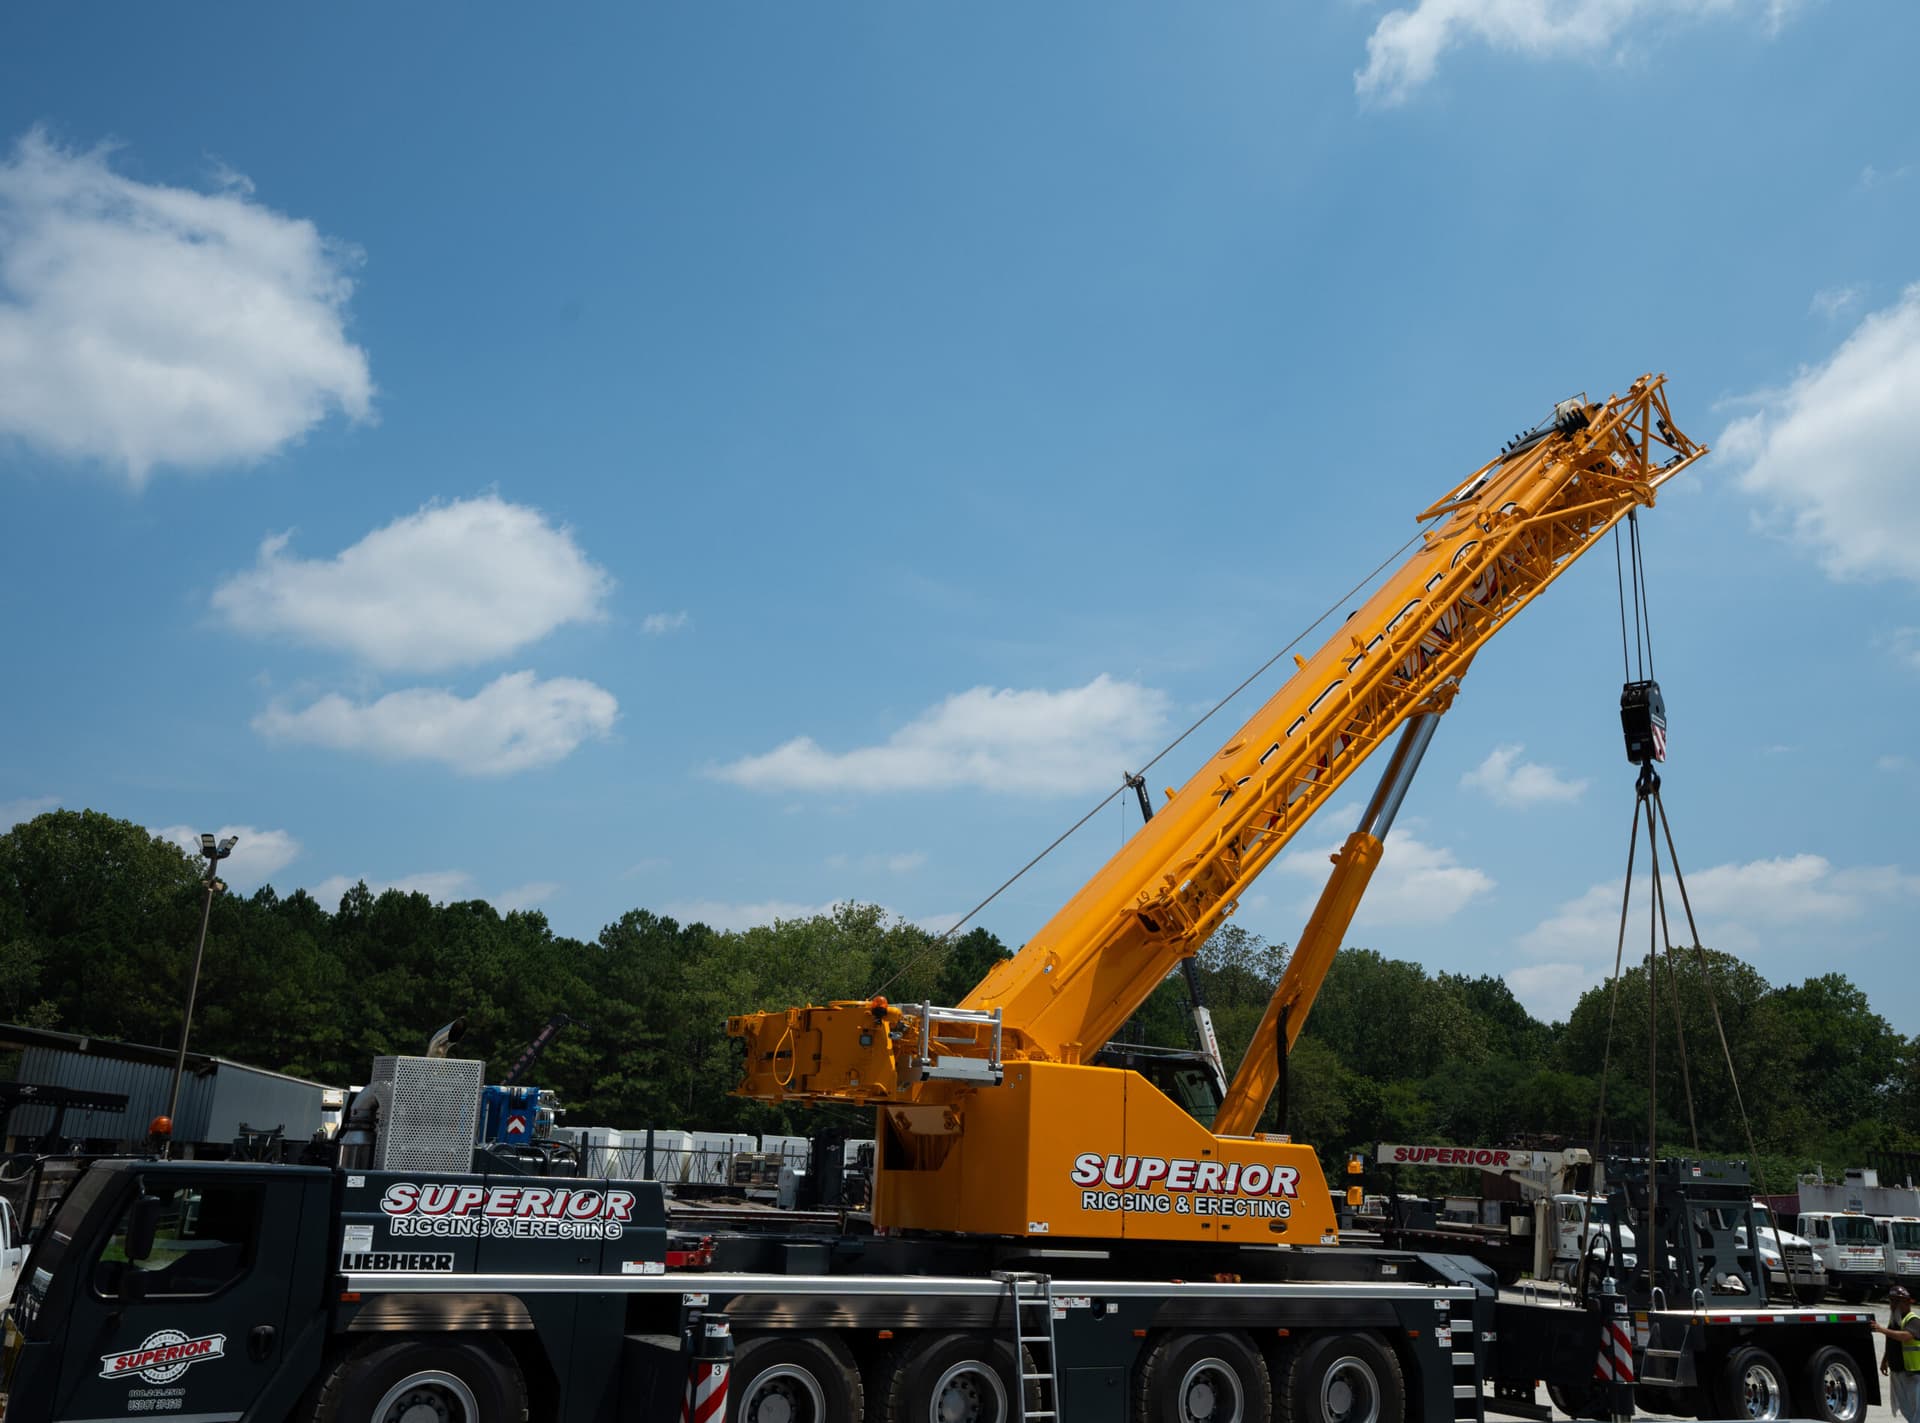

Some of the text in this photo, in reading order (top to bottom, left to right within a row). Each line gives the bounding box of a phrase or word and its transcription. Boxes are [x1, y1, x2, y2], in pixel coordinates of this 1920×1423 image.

[1393, 1147, 1511, 1167] SUPERIOR
[1071, 1153, 1300, 1199] SUPERIOR
[382, 1184, 636, 1221] SUPERIOR
[1082, 1191, 1291, 1218] RIGGING & ERECTING
[391, 1216, 623, 1240] RIGGING & ERECTING
[341, 1253, 453, 1271] LIEBHERR
[114, 1340, 212, 1370] SUPERIOR
[714, 1364, 722, 1376] 3
